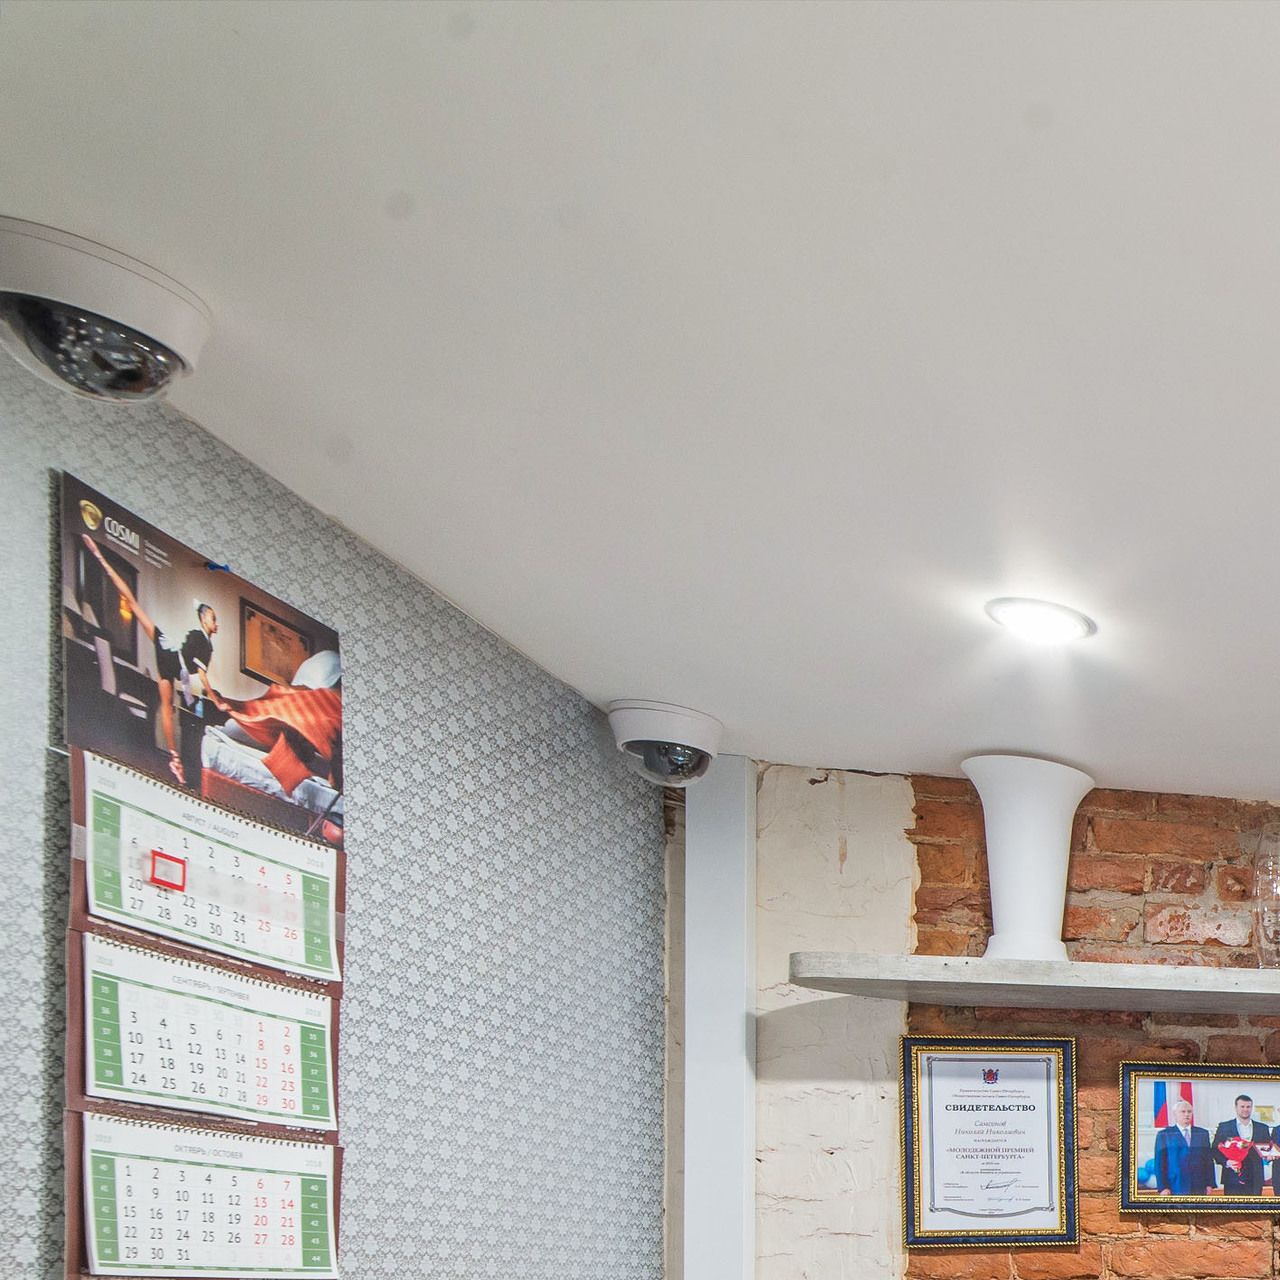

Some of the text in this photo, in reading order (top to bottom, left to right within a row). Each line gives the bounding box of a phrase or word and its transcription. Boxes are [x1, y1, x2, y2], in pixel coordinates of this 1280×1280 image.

[182, 837, 292, 886] 1 2 3 4 5
[128, 876, 144, 891] 20
[181, 894, 196, 910] 22
[207, 902, 222, 918] 23
[232, 911, 247, 925] 24
[257, 919, 272, 933] 25
[284, 926, 298, 940] 26
[129, 896, 247, 945] 27 28 29 30 31
[130, 1010, 138, 1024] 3
[159, 1018, 169, 1030] 4
[189, 1023, 197, 1036] 5
[216, 1028, 223, 1041] 6
[257, 1039, 265, 1051] 8
[283, 1044, 291, 1056] 9
[257, 1021, 290, 1038] 1 2
[127, 1031, 295, 1075] 10 11 12 13 14 15 16
[129, 1051, 296, 1093] 17 18 19 20 21 22 23
[130, 1071, 296, 1111] 24 25 26 27 28 29 30
[945, 1104, 1036, 1113] СВИДЕТЕЛЬСТВО
[125, 1164, 291, 1191] 1 2 3 4 5 6 7
[125, 1184, 295, 1210] 8 9 10 11 12 13 14
[123, 1205, 295, 1228] 15 16 17 18 19 20 21
[123, 1225, 295, 1247] 22 23 24 25 26 27 28
[124, 1246, 191, 1261] 29 30 31
